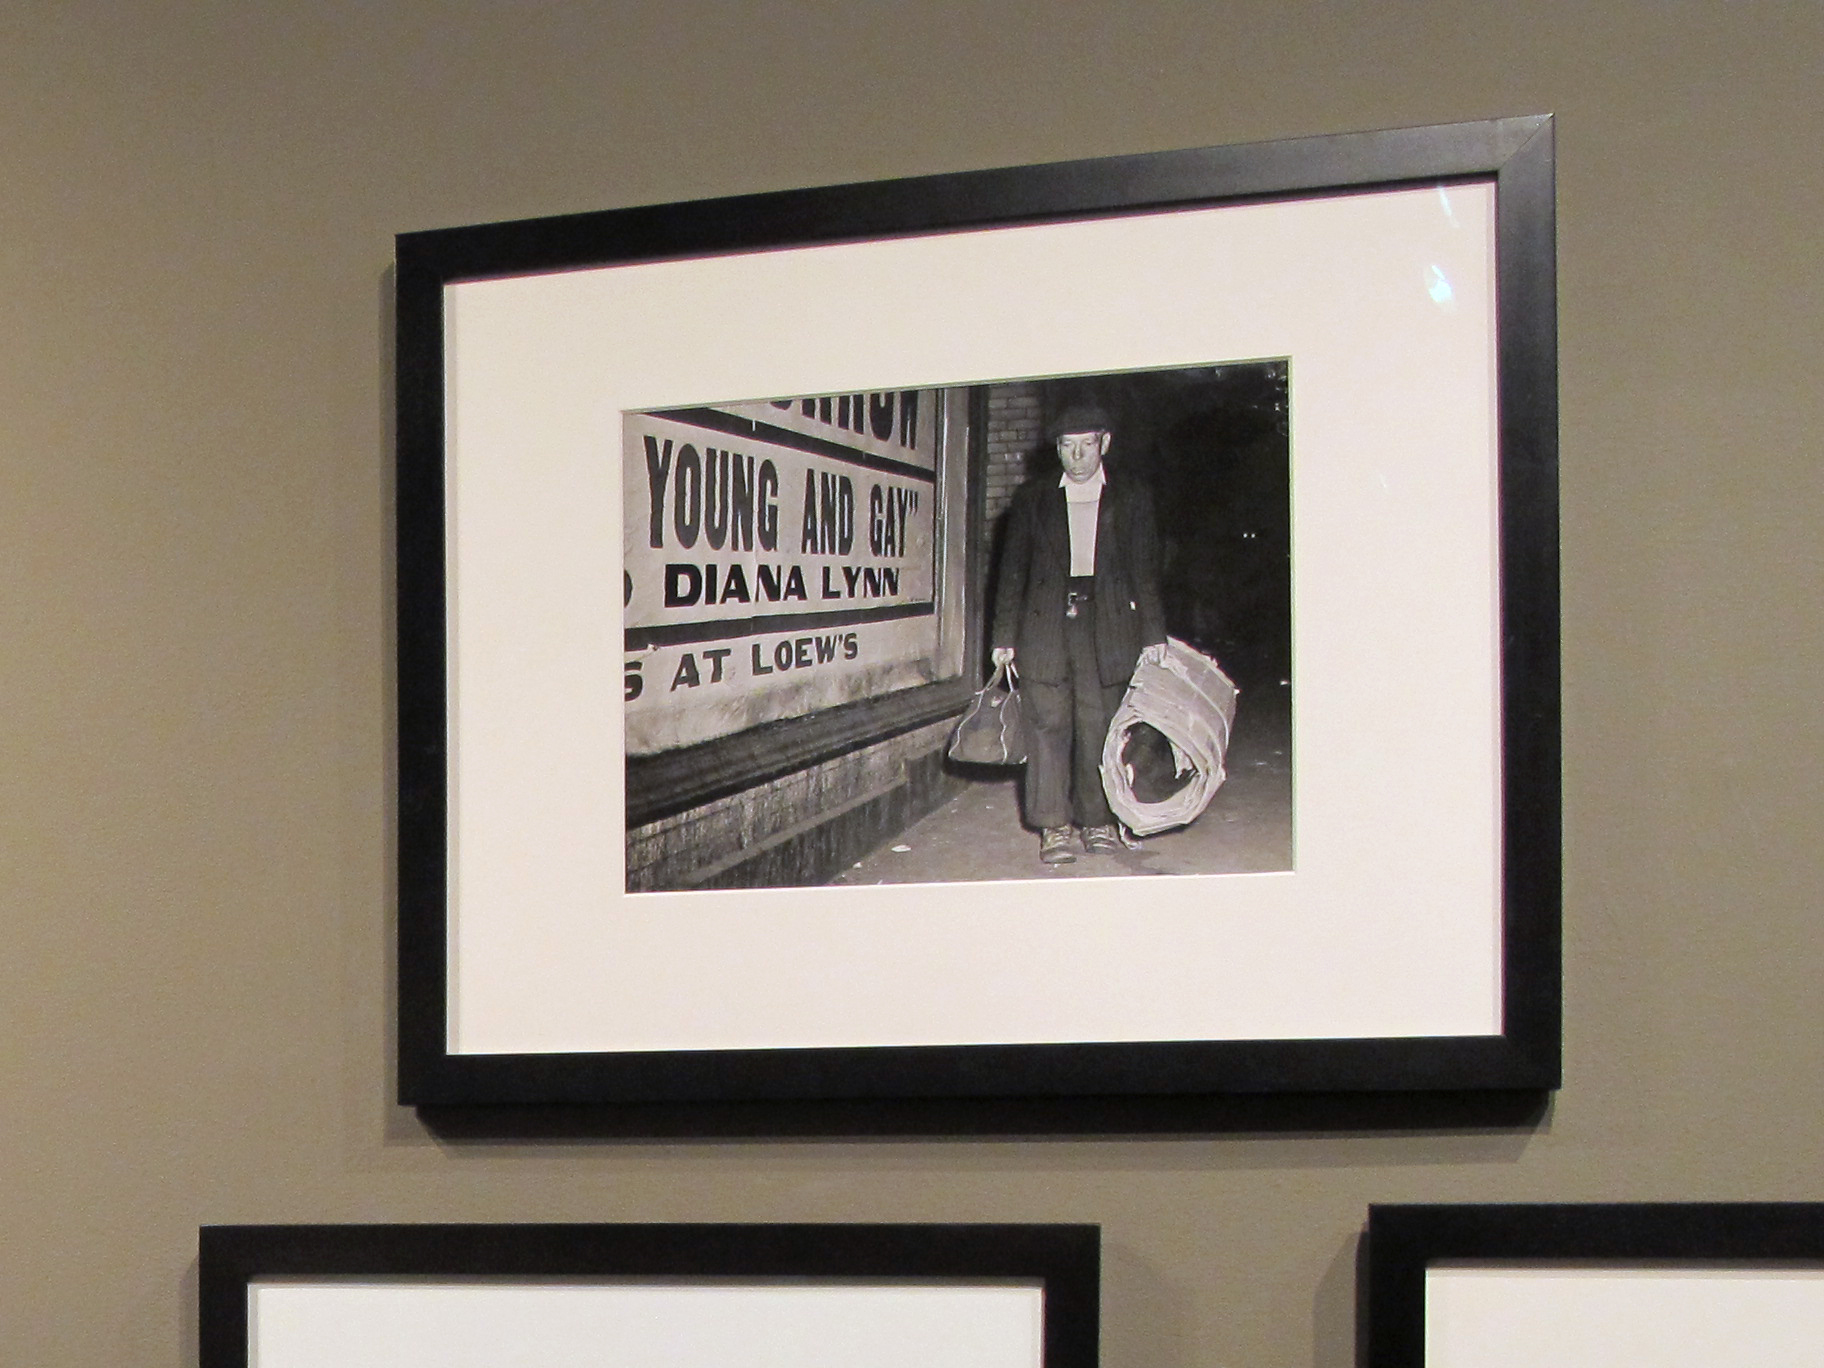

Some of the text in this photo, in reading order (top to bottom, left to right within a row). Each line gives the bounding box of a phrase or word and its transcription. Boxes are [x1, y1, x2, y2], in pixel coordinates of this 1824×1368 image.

[643, 435, 778, 552] YOUNG
[801, 469, 855, 556] AND
[663, 563, 808, 608] DIANA
[821, 565, 900, 600] LYNN
[670, 648, 732, 692] AT
[751, 632, 859, 677] LOEW'S
